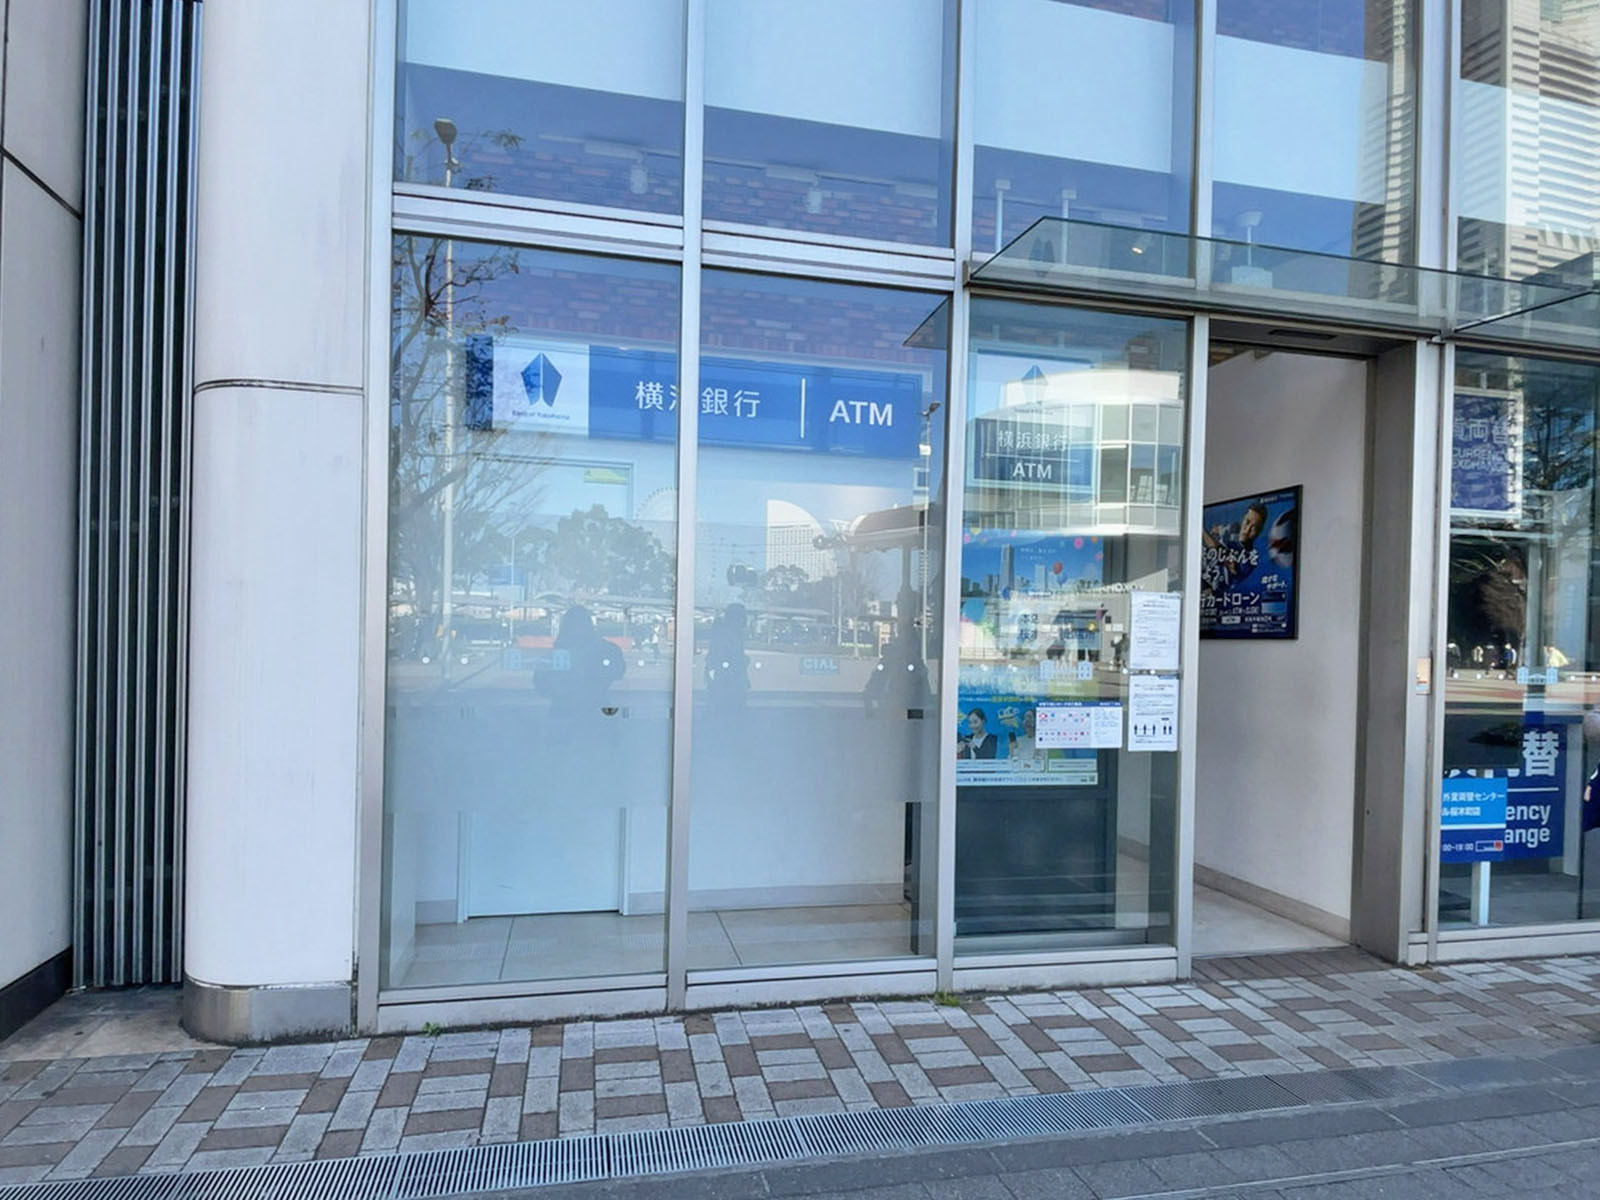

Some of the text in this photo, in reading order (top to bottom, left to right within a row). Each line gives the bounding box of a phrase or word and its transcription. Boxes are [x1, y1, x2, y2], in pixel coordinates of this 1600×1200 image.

[634, 380, 761, 418] 横銀行
[829, 399, 894, 427] ATM
[996, 430, 1068, 452] 横浜銀行
[1012, 461, 1053, 480] ATM
[1506, 804, 1552, 826] ency
[1503, 826, 1551, 849] ange
